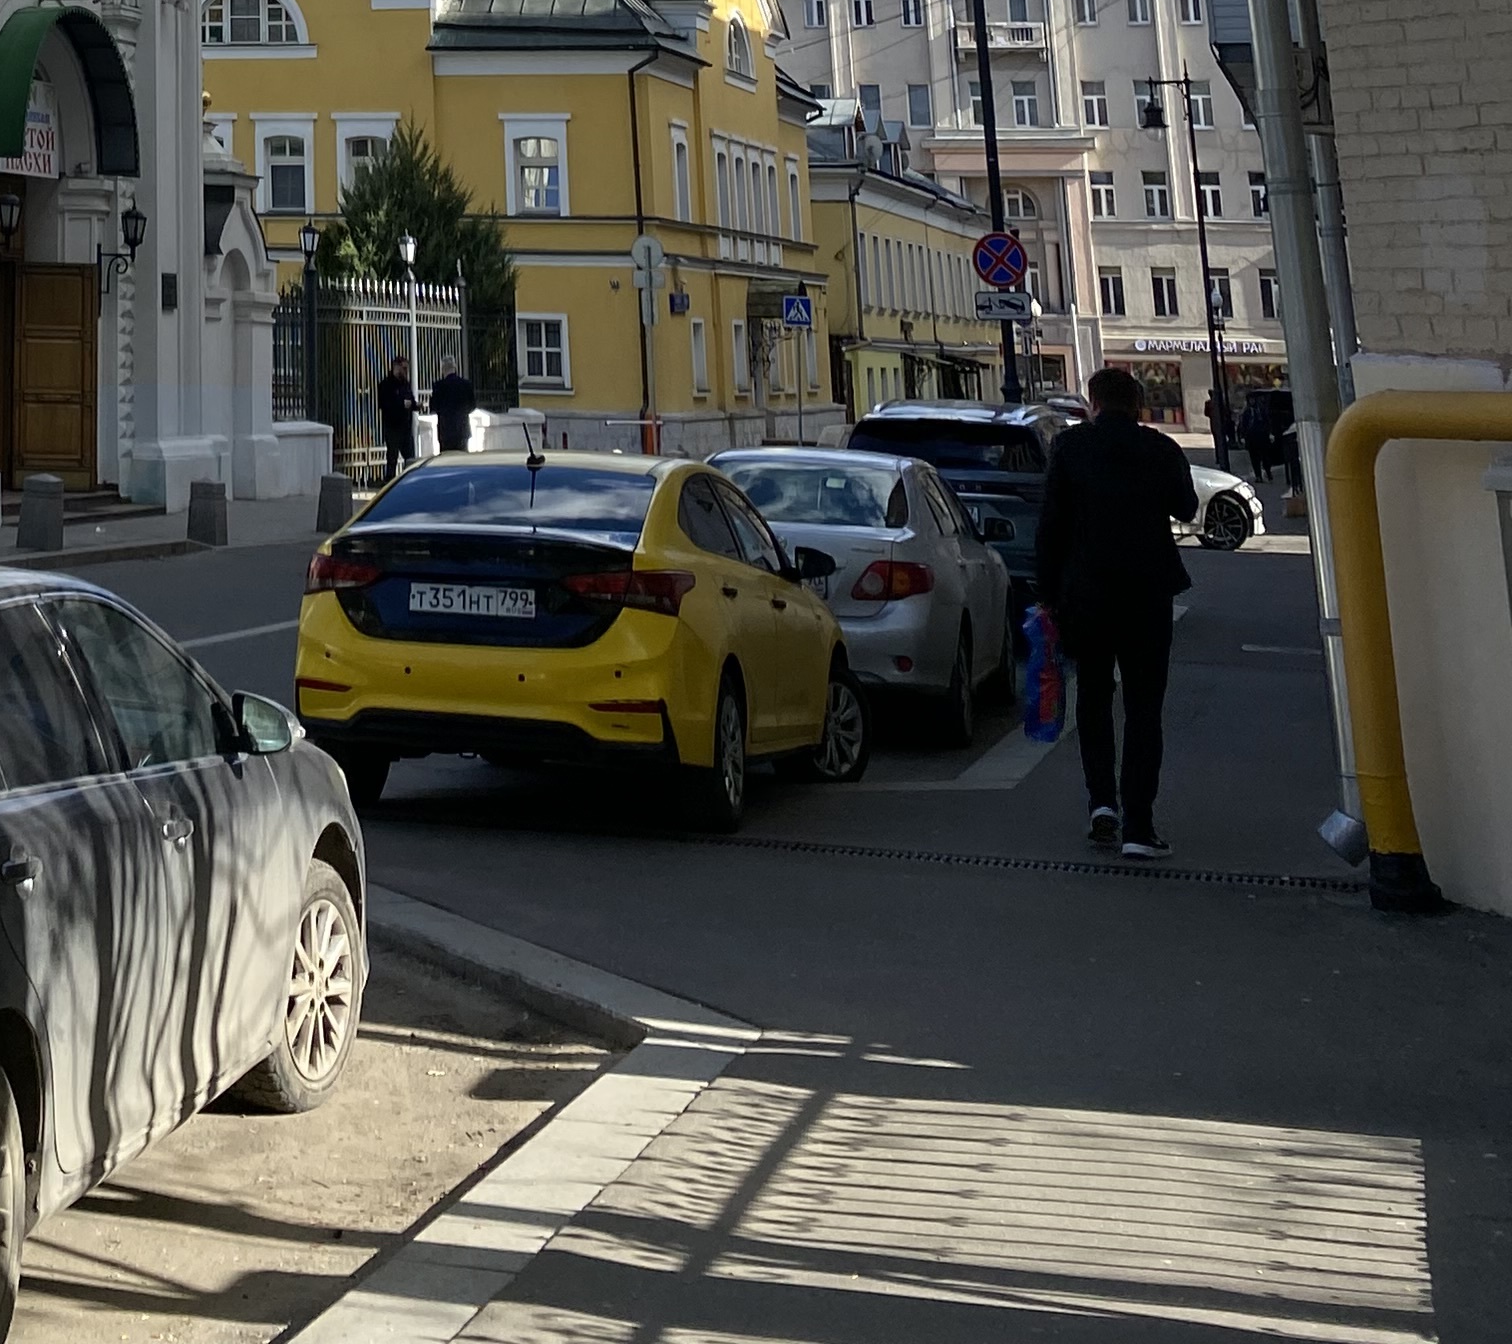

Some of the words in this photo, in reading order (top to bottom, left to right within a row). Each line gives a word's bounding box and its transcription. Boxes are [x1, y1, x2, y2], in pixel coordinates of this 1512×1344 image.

[26, 126, 55, 151] ТОЙ
[416, 587, 494, 612] Т351НТ
[498, 590, 529, 608] 799
